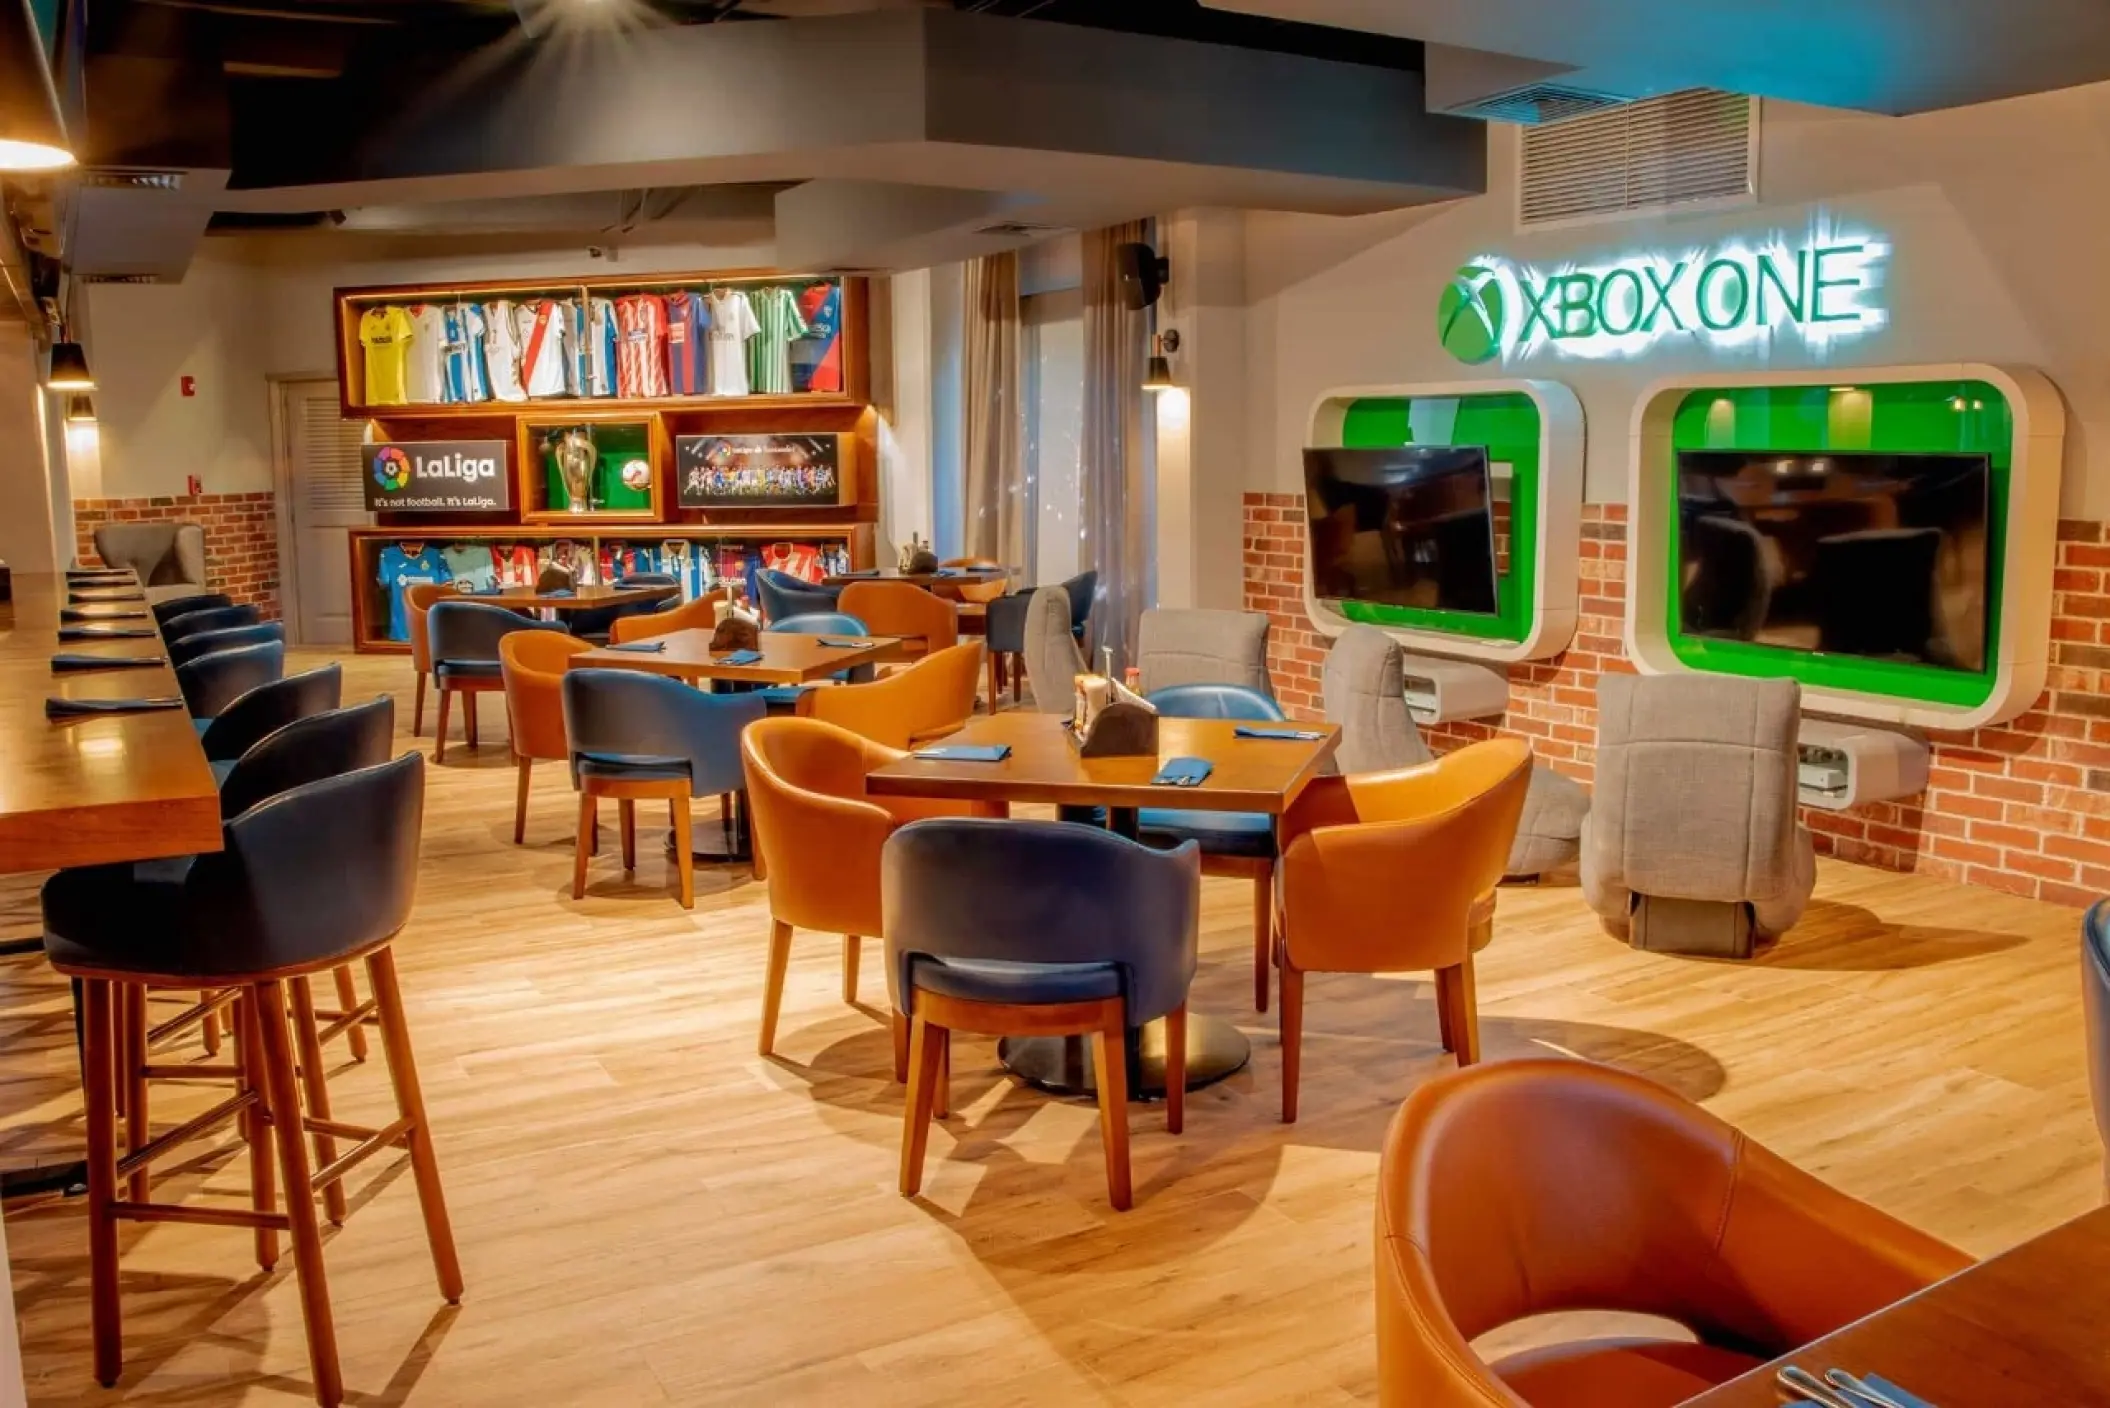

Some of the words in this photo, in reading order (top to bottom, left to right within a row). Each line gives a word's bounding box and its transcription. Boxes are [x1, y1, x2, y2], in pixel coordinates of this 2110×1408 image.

[1517, 261, 1685, 343] XBOX
[1695, 245, 1865, 332] ONE
[415, 452, 496, 483] LaLiga
[374, 497, 389, 507] It's
[390, 498, 405, 507] not
[447, 496, 461, 507] It's
[462, 496, 497, 509] LaLiga.
